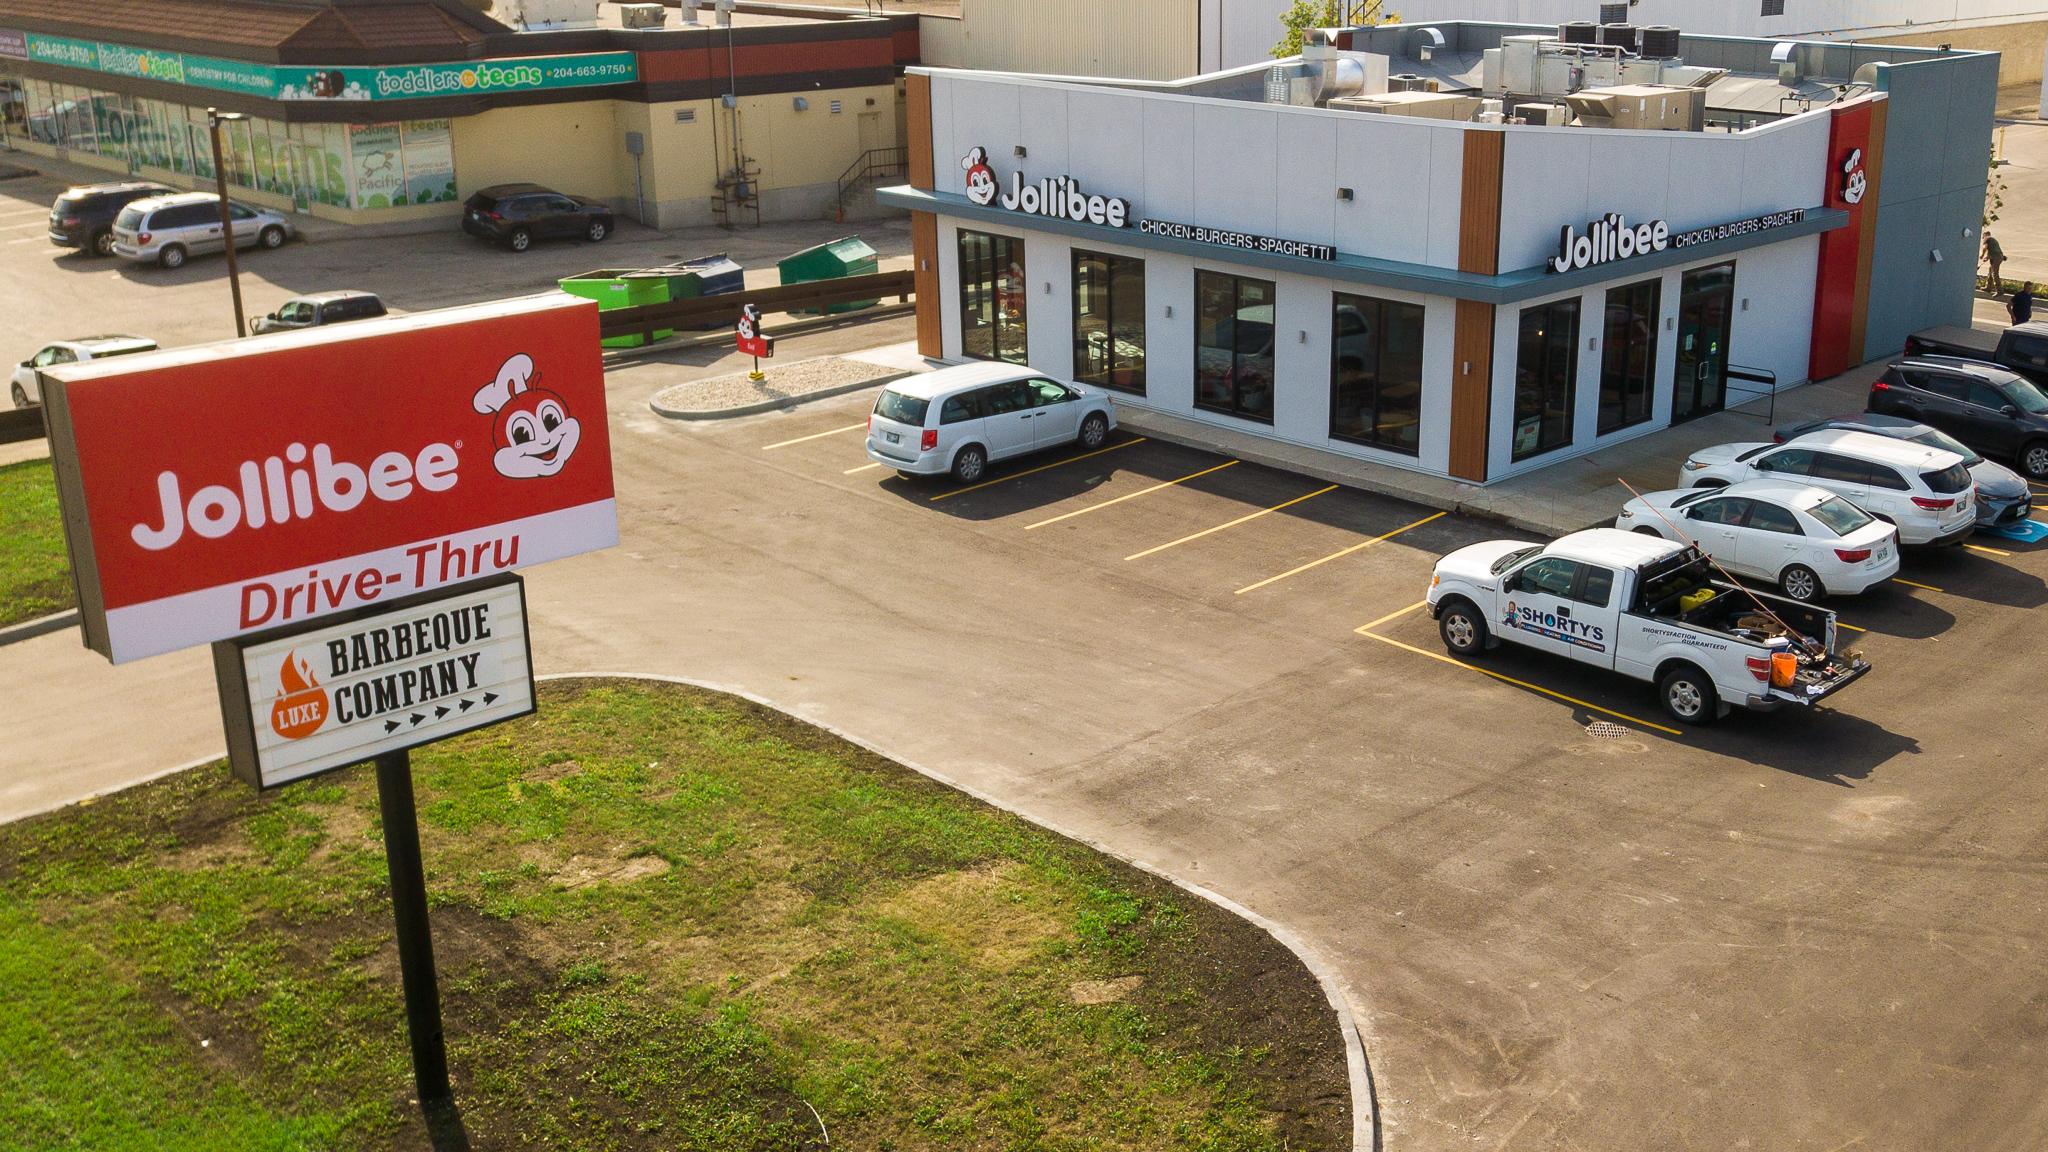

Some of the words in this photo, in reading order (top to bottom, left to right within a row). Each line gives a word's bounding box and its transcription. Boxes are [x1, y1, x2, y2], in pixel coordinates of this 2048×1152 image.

[148, 50, 182, 81] teens
[376, 67, 460, 95] toddlers
[476, 64, 542, 86] teens
[553, 63, 626, 79] 204-663-9750
[359, 174, 401, 190] Pacific
[1001, 170, 1131, 228] Jollibee
[1139, 218, 1191, 240] CHICKEN
[1195, 227, 1254, 250] BURGERS
[1259, 237, 1332, 262] SPAGHETTI
[1554, 213, 1669, 273] Jollibee
[1675, 230, 1716, 249] CHICKEN
[1718, 220, 1759, 240] BURGERS
[1762, 208, 1807, 231] SPAGHETTI
[131, 442, 460, 551] Jollibee
[239, 534, 520, 631] Drive-Thru
[326, 602, 492, 678] BARBEQUE
[1521, 606, 1604, 641] SHORTY'S
[333, 652, 481, 725] COMPANY
[277, 701, 321, 731] LUXE
